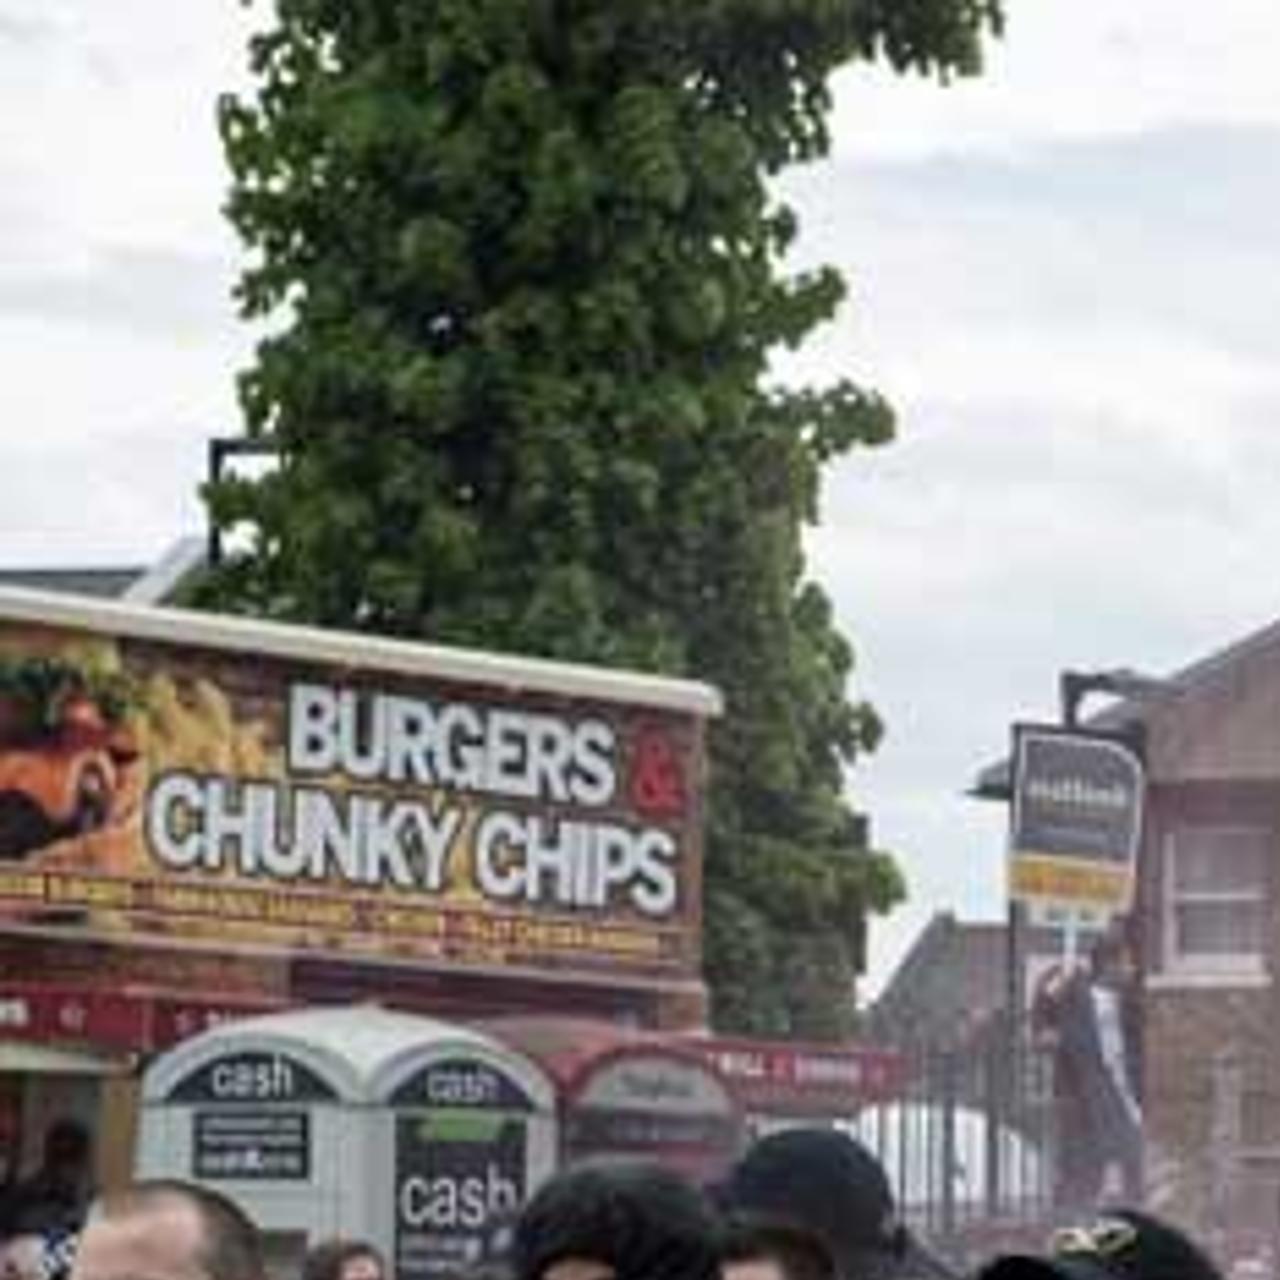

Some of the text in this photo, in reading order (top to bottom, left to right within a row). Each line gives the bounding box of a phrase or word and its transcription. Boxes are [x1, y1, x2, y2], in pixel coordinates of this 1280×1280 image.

[290, 684, 682, 814] BURGERS &
[149, 776, 677, 913] CHUNKY CHIPS
[212, 1053, 292, 1096] cash
[427, 1068, 497, 1100] cash
[402, 1163, 517, 1226] cash
